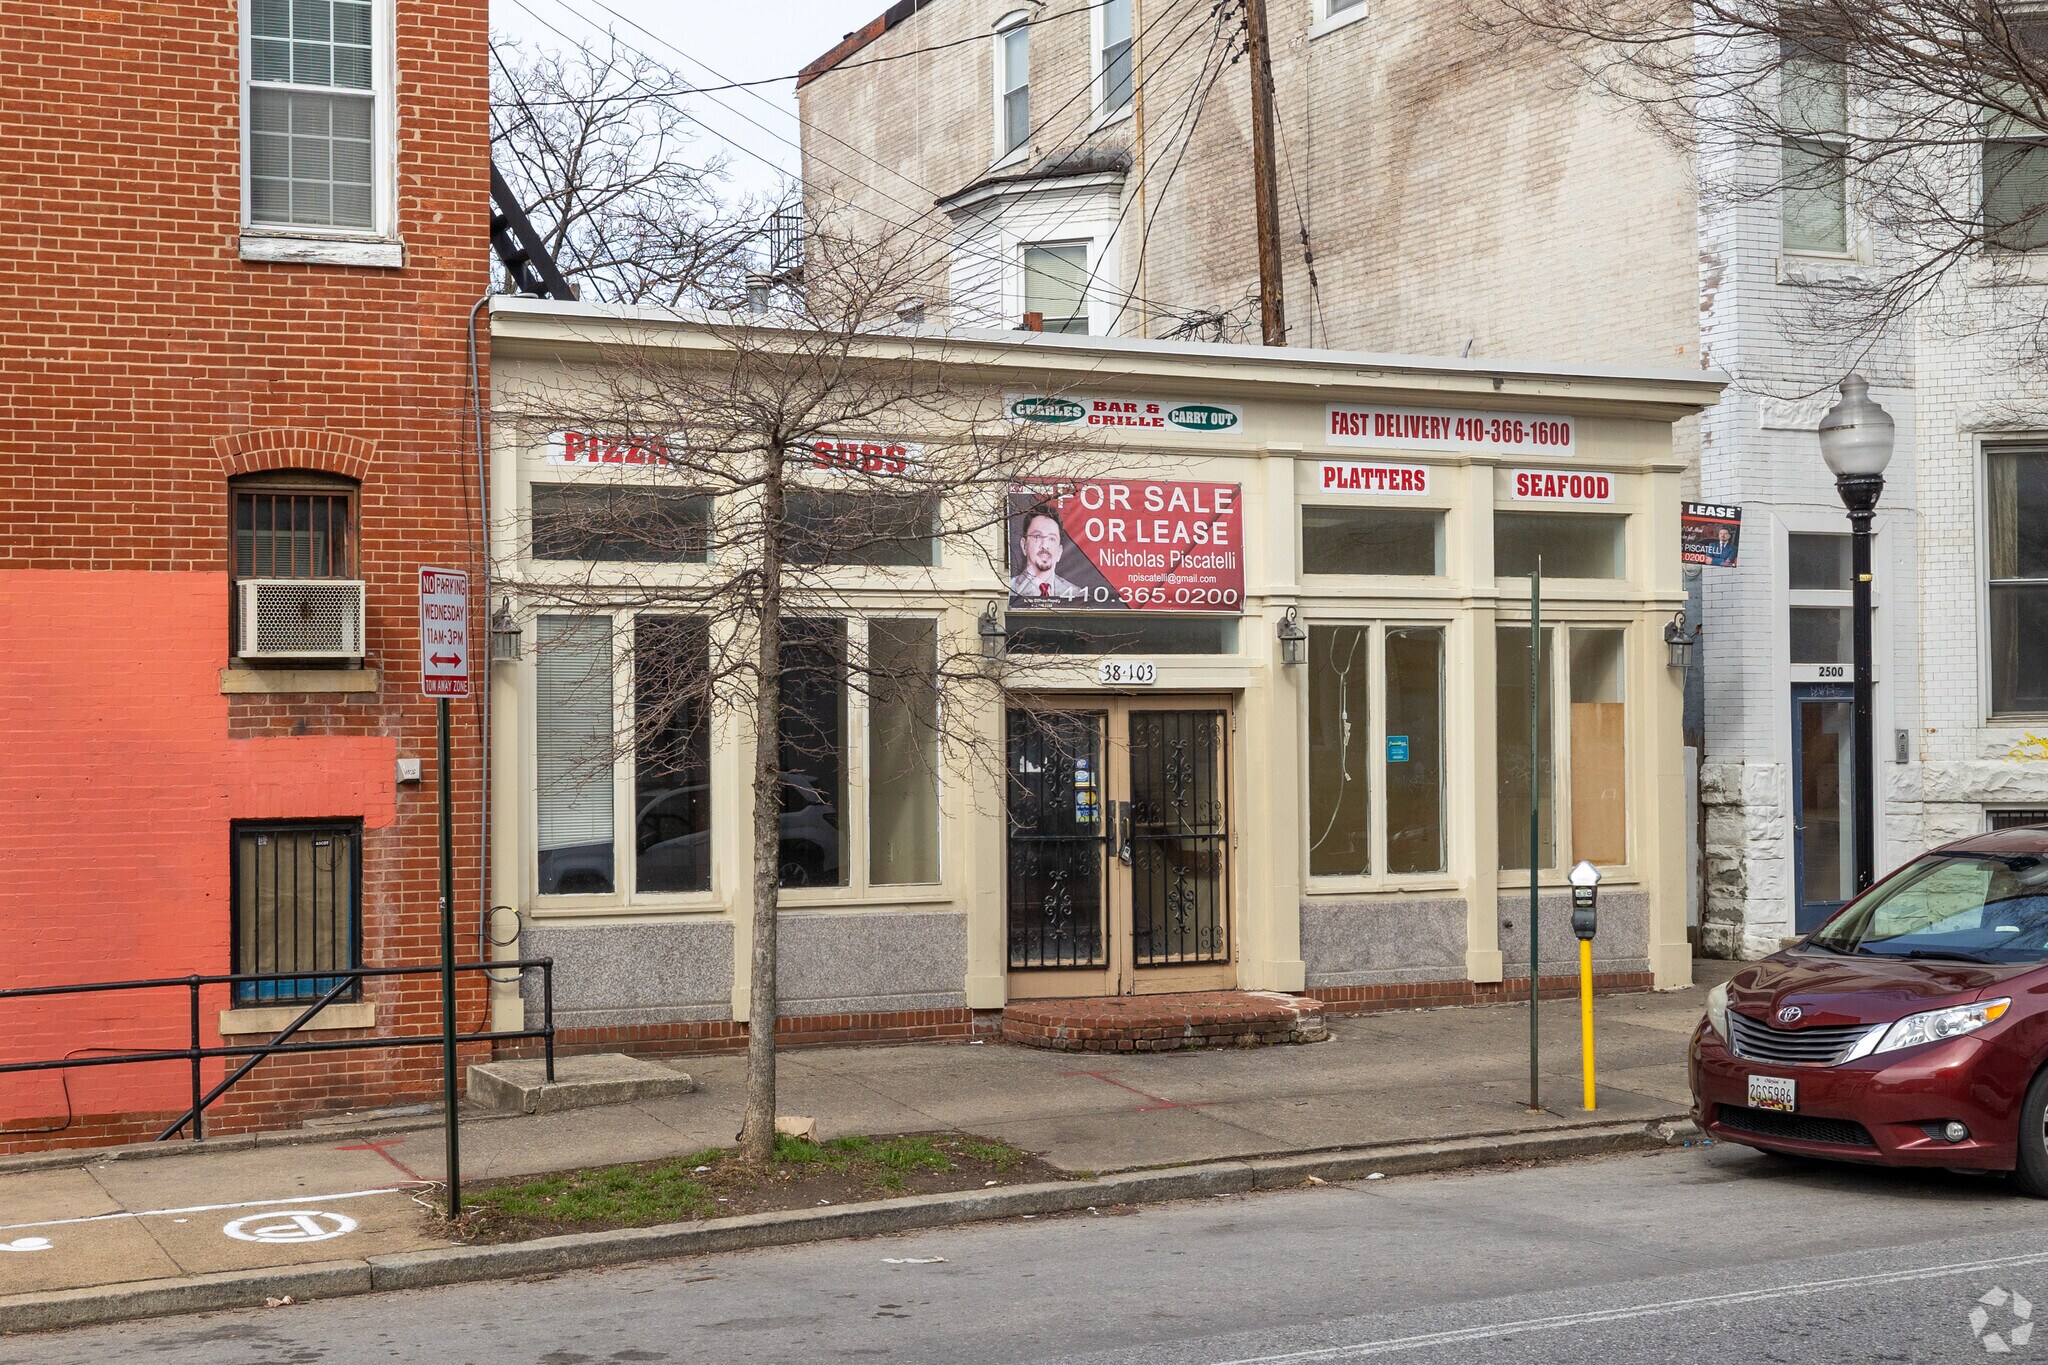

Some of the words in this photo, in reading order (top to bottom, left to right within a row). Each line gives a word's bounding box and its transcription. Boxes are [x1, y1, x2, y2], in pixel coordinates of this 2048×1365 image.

[1016, 405, 1082, 417] CHARLES
[1093, 401, 1138, 413] BAR
[1146, 404, 1160, 414] &
[1088, 414, 1164, 427] GRILLE
[1171, 410, 1207, 424] CARRY
[1210, 413, 1234, 426] OUT
[1331, 411, 1369, 436] FAST
[1374, 413, 1451, 440] DELIVERY
[1455, 417, 1570, 446] 410-366-1600
[564, 432, 668, 465] PIZZA
[813, 441, 907, 473] SUBS
[1323, 466, 1426, 491] PLATTERS
[1517, 473, 1610, 499] SEAFOOD
[1058, 483, 1131, 511] FOR
[1144, 486, 1234, 514] SALE
[1688, 504, 1735, 518] LEASE
[1085, 517, 1127, 543] OR
[1137, 520, 1229, 545] LEASE
[1099, 548, 1165, 568] Nicholas
[1170, 550, 1236, 570] Piscatelli
[423, 575, 434, 593] NO
[436, 577, 465, 595] PARKING
[1128, 573, 1217, 584] npiscatelli@gmail.com
[1060, 586, 1238, 605] 410.365.0200
[425, 603, 465, 621] WEDNESDAY
[1819, 666, 1844, 677] 2500
[425, 679, 436, 692] TOW
[437, 680, 452, 692] AWAY
[453, 680, 468, 692] ZONE
